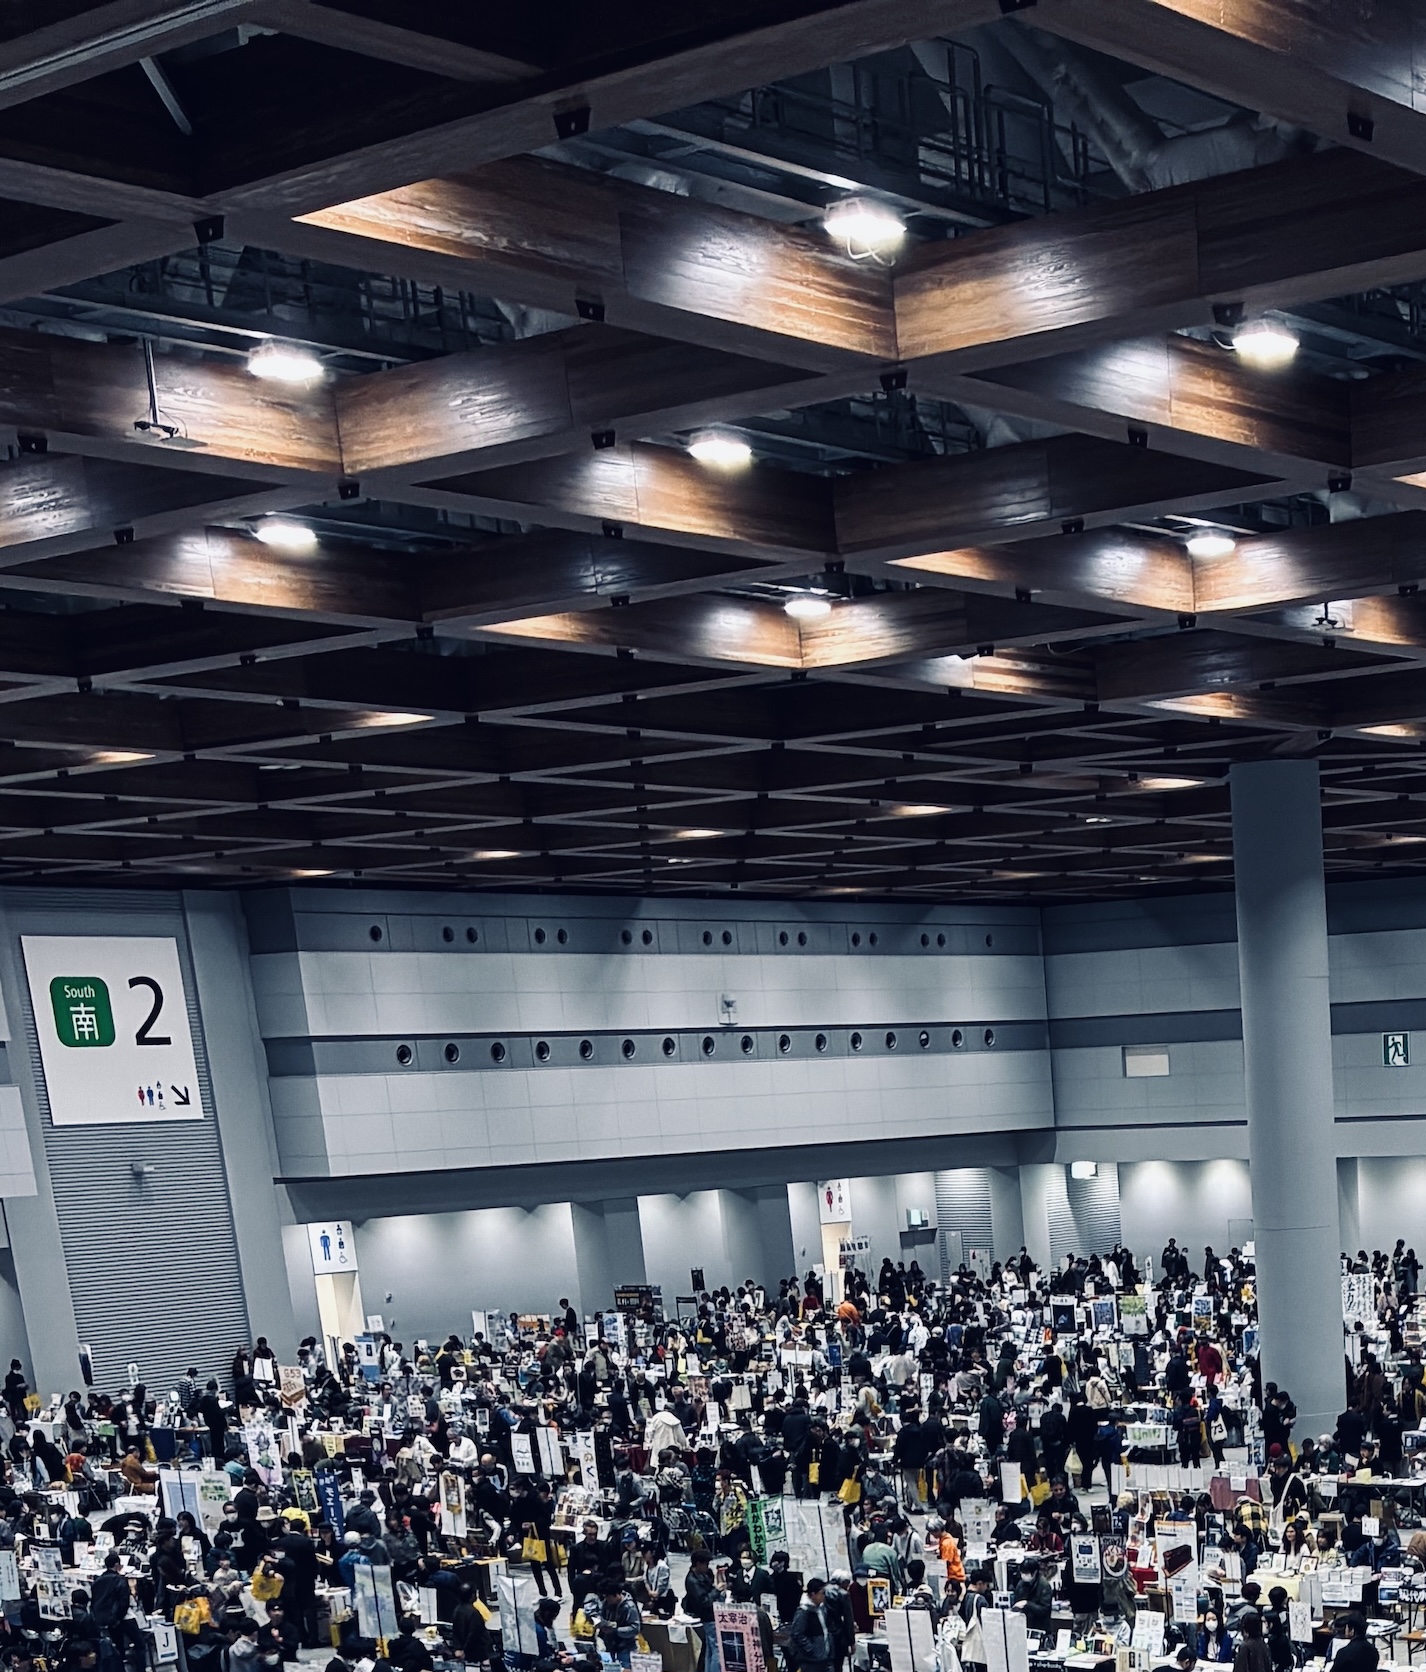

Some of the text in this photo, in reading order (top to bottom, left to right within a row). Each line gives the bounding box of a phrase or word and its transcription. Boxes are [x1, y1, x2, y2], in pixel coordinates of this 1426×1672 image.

[63, 984, 95, 999] South
[128, 976, 172, 1046] 2
[69, 1002, 99, 1041] 南
[718, 1612, 748, 1625] 太宰治
[162, 1632, 170, 1648] J
